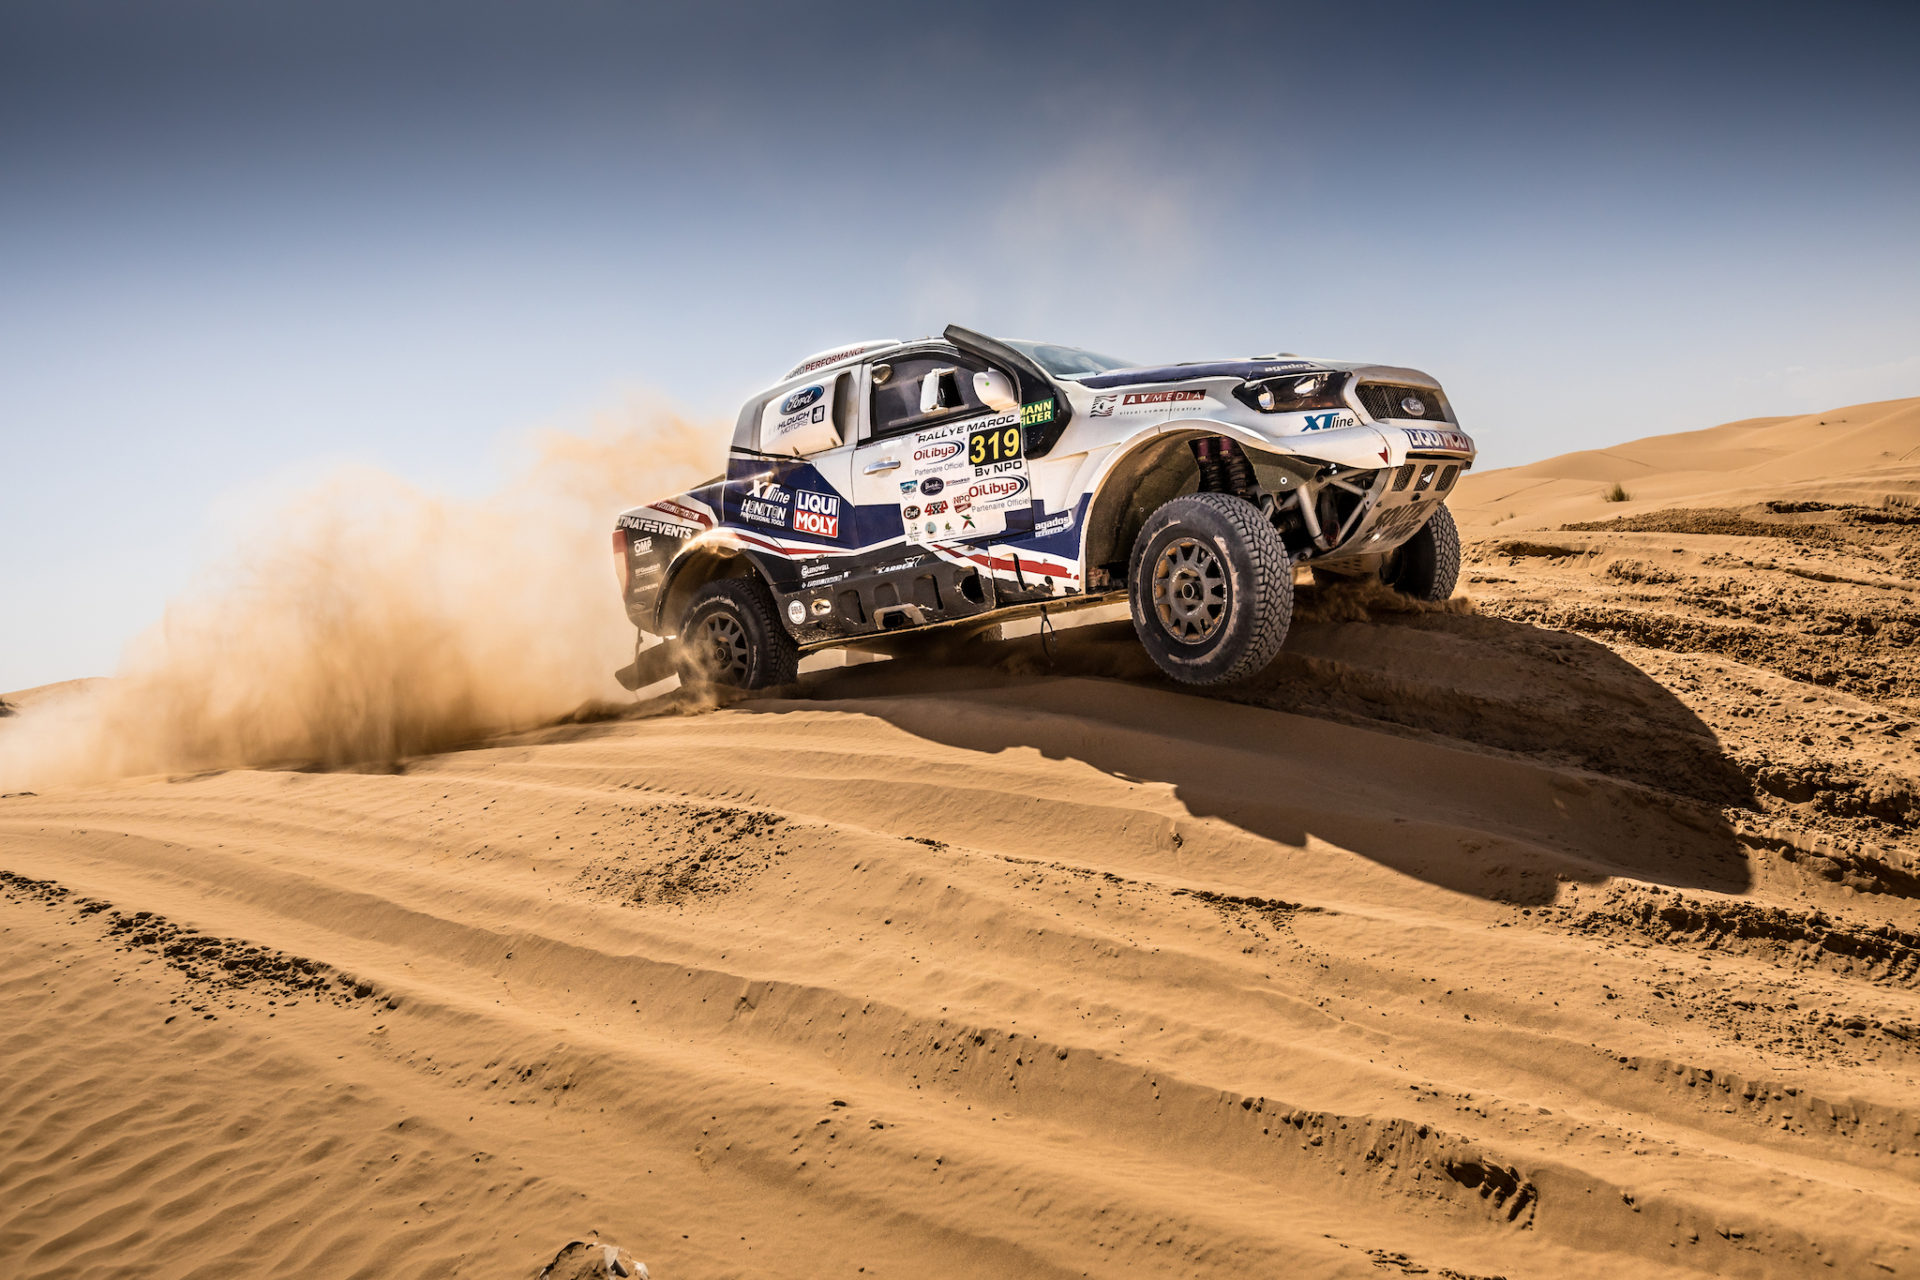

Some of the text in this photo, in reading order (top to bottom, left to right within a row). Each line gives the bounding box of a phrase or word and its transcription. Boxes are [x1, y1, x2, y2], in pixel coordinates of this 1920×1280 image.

[805, 347, 865, 372] PERFORMANCE
[786, 389, 815, 411] Ford
[778, 411, 810, 430] HLOUCH
[780, 419, 808, 435] MOTORS
[918, 425, 964, 443] RALLYE
[966, 415, 1015, 432] MAROC
[1301, 413, 1354, 432] XTline
[970, 428, 1020, 464] 319
[1405, 429, 1444, 447] LIQUI
[913, 445, 956, 461] OiLibya
[914, 462, 964, 476] Partenaire Officiel
[975, 461, 1022, 477] Bv NPO
[747, 480, 791, 504] XTline
[968, 482, 1018, 498] OiLibya
[797, 492, 837, 516] LIQUI
[953, 494, 971, 504] NPO
[971, 501, 1006, 513] Partenaire
[1007, 497, 1031, 508] Officiel
[770, 518, 786, 527] TOOLS
[795, 510, 838, 534] MOLY
[1035, 516, 1069, 531] agados
[634, 540, 653, 553] OMP
